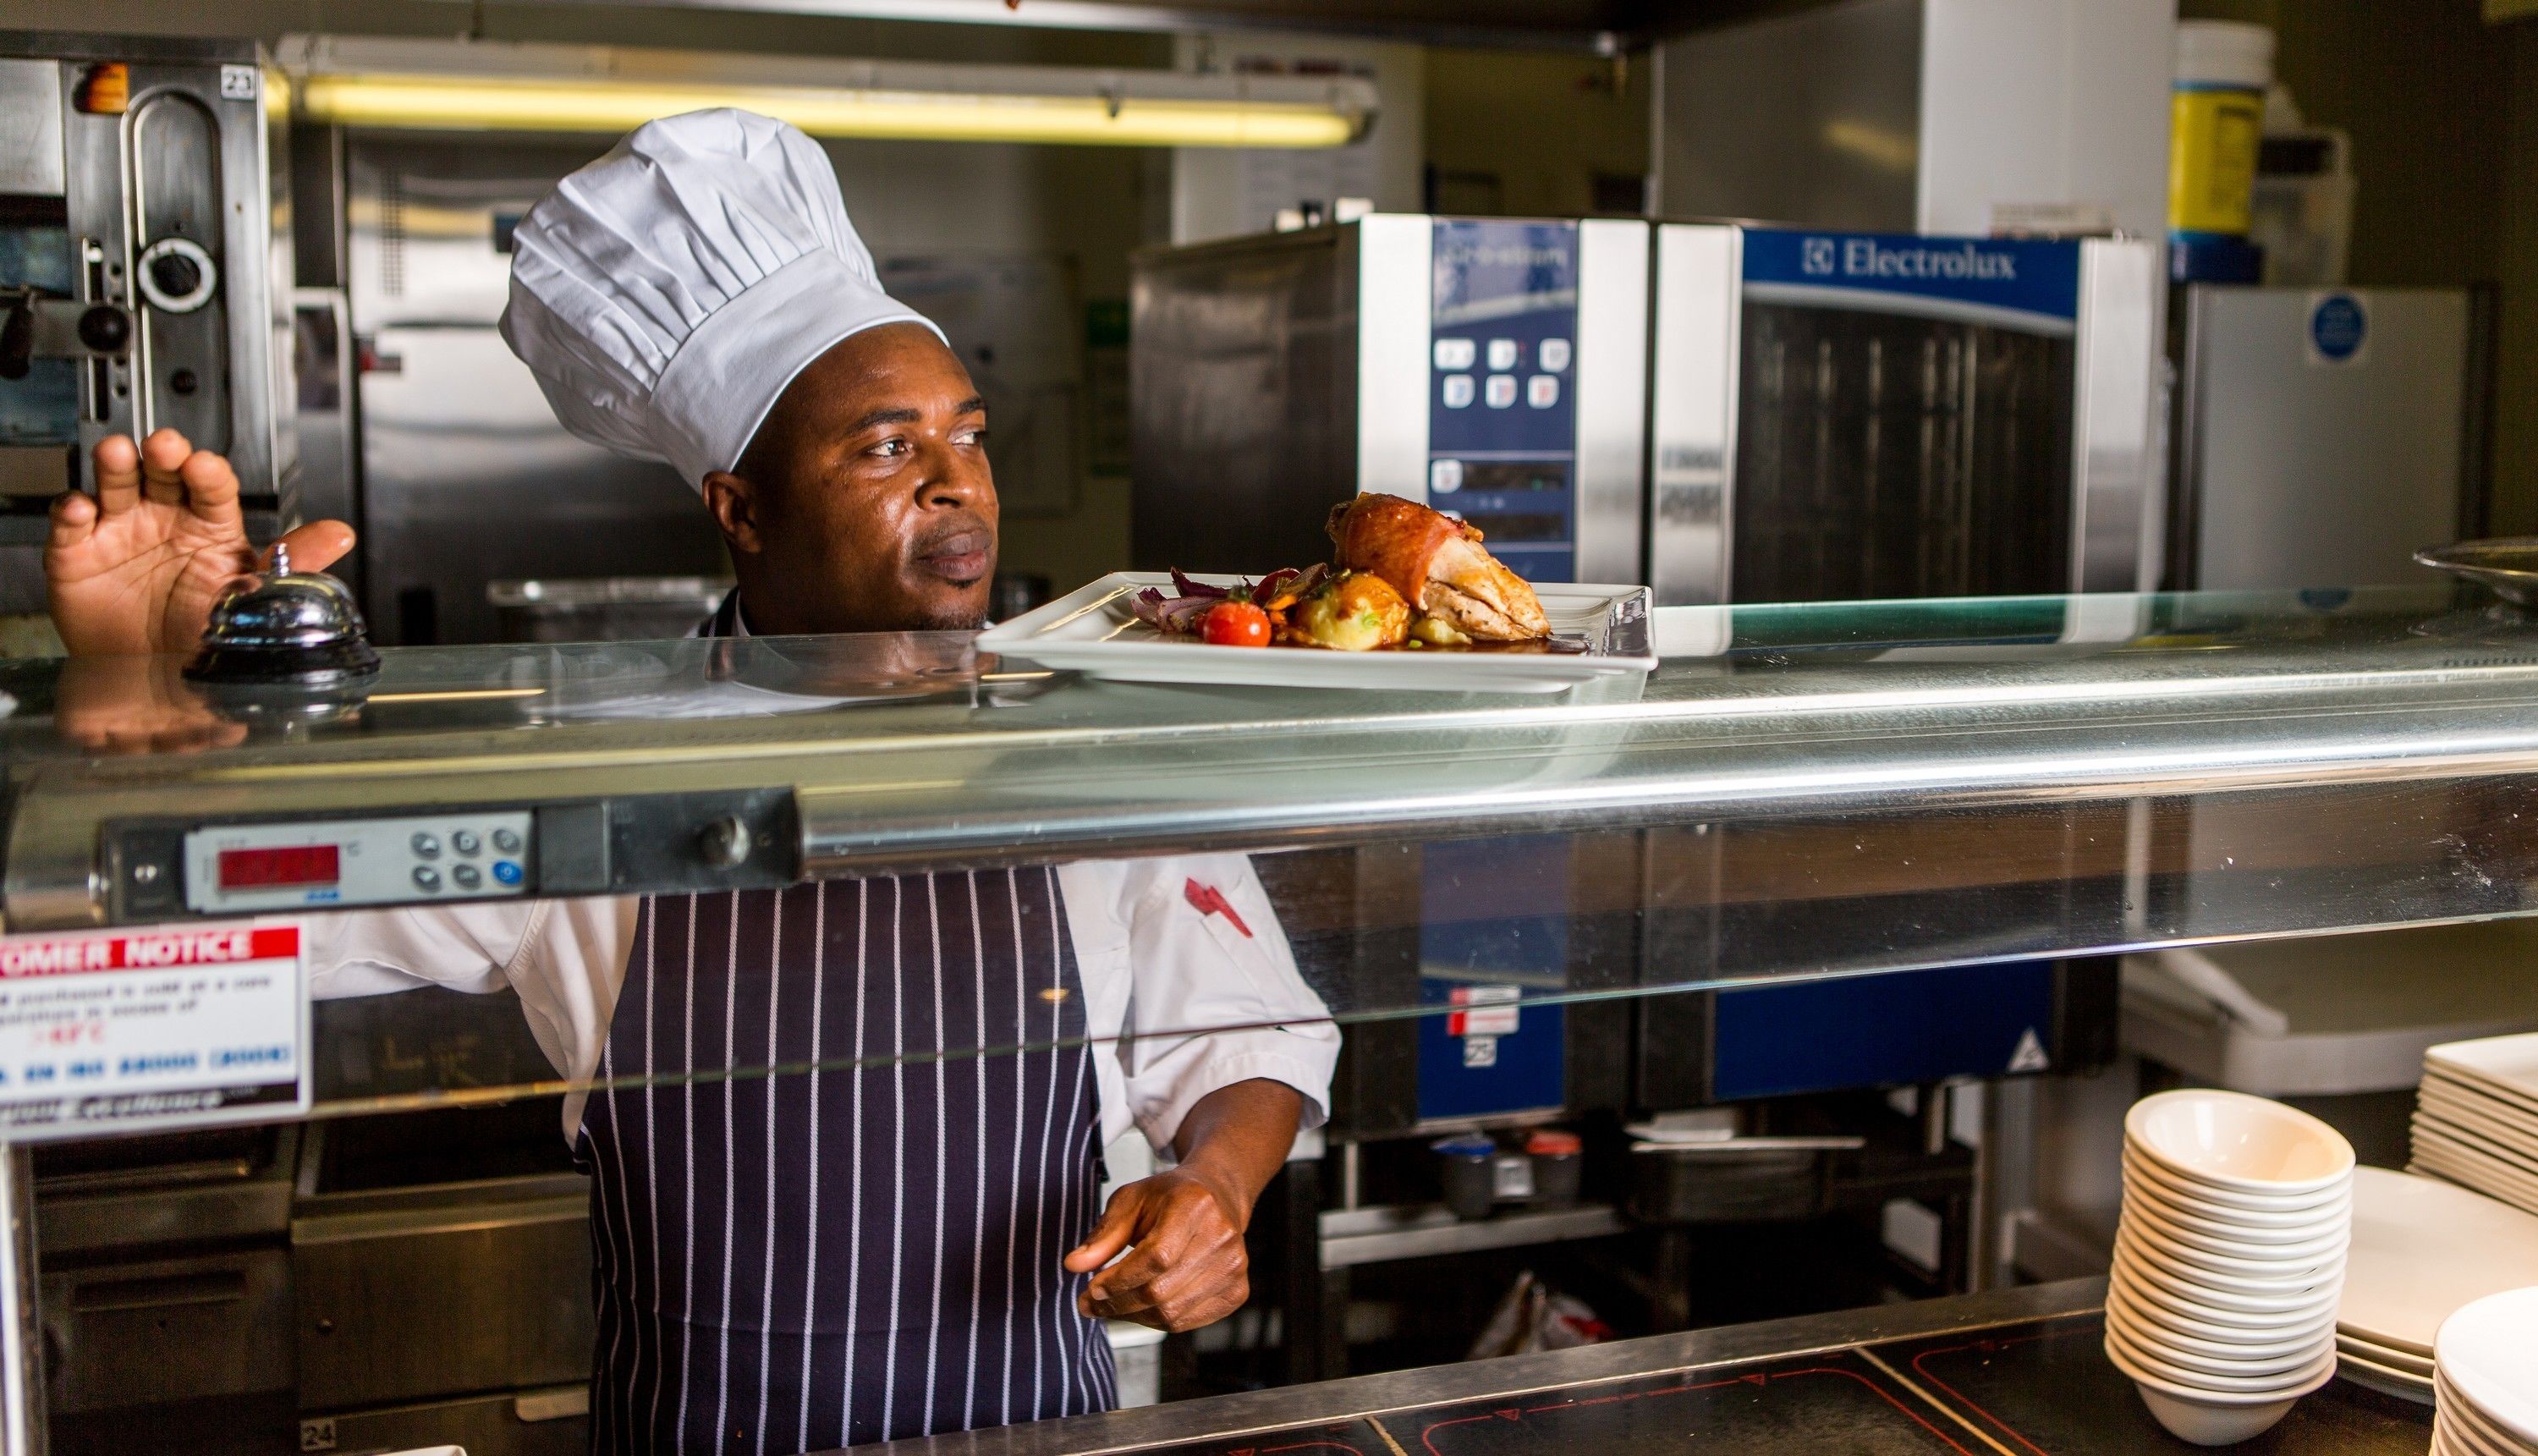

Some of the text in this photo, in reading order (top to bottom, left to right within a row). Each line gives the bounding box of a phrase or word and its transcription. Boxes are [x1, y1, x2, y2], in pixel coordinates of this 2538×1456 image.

[1843, 239, 2016, 279] Electrolux
[0, 931, 252, 974] OMER NOTICE
